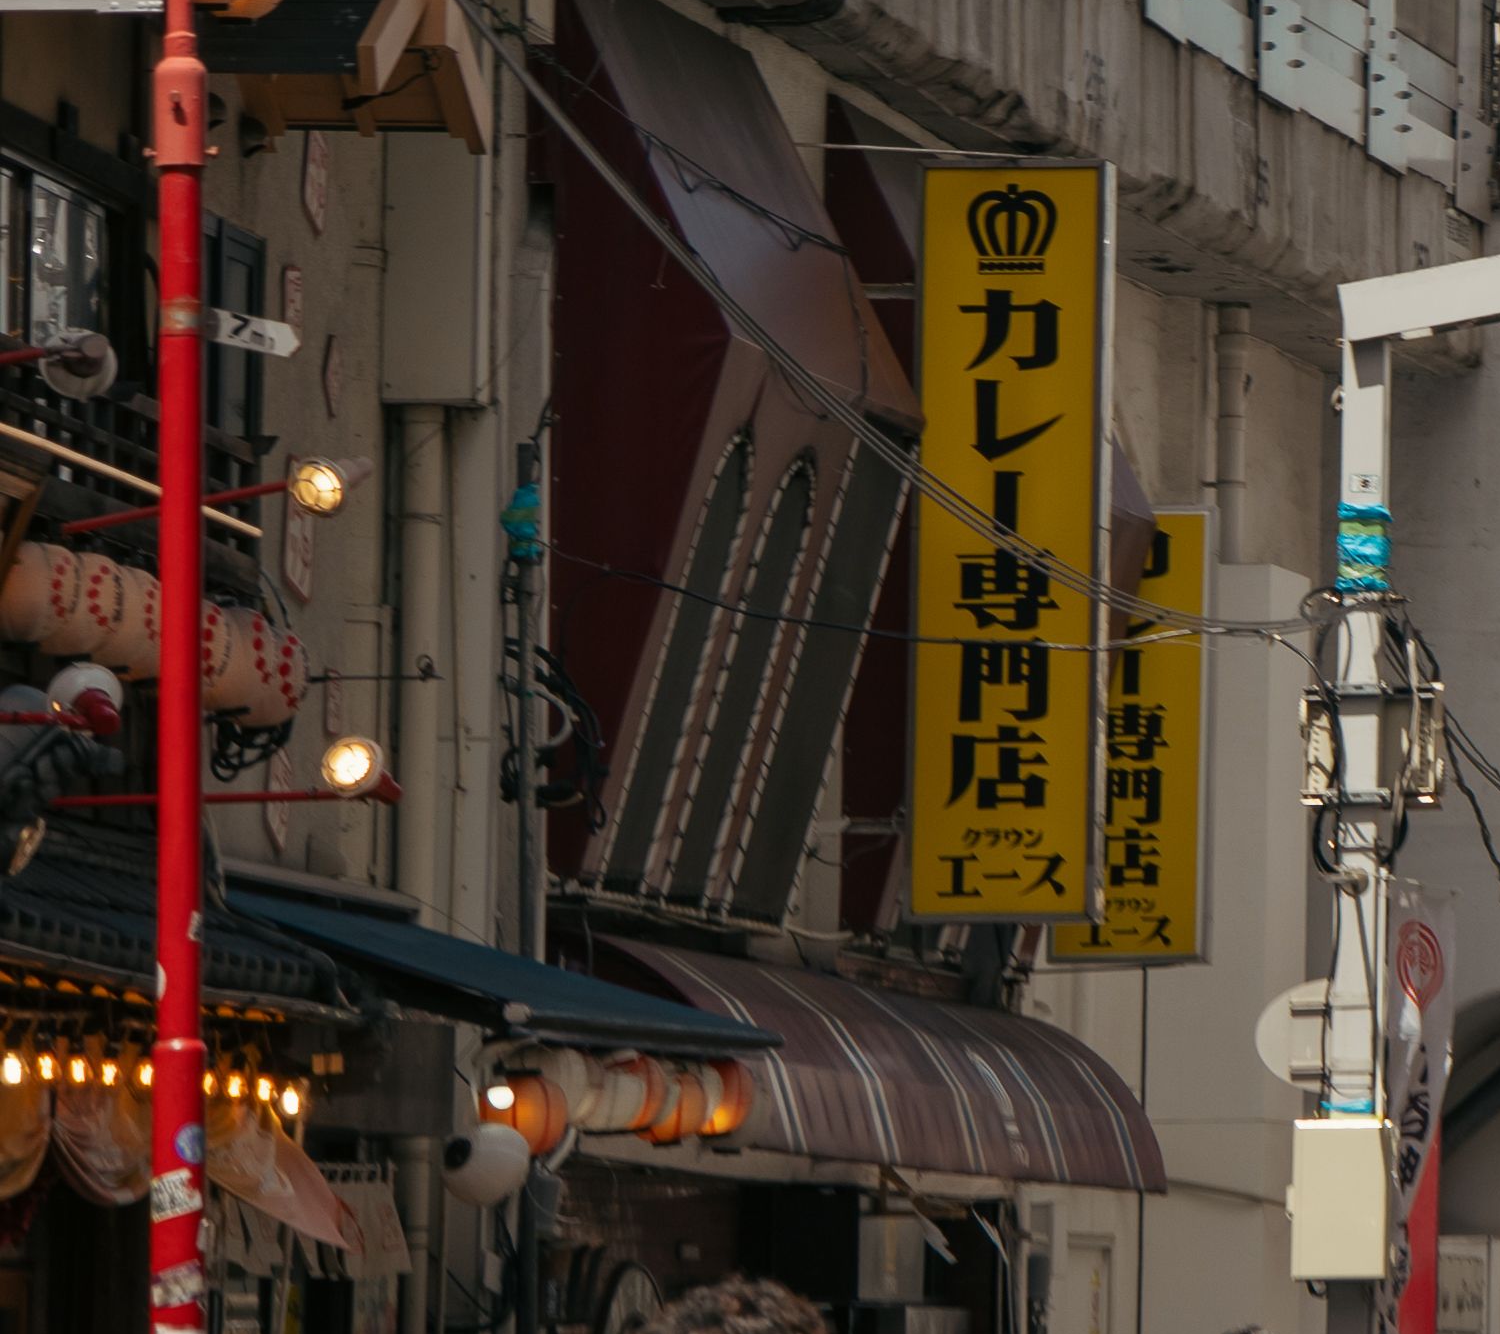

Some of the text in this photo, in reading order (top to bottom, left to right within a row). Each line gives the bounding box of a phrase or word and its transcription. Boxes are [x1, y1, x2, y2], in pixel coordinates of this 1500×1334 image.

[945, 288, 1067, 812] カレー専門店
[936, 852, 1068, 898] エース
